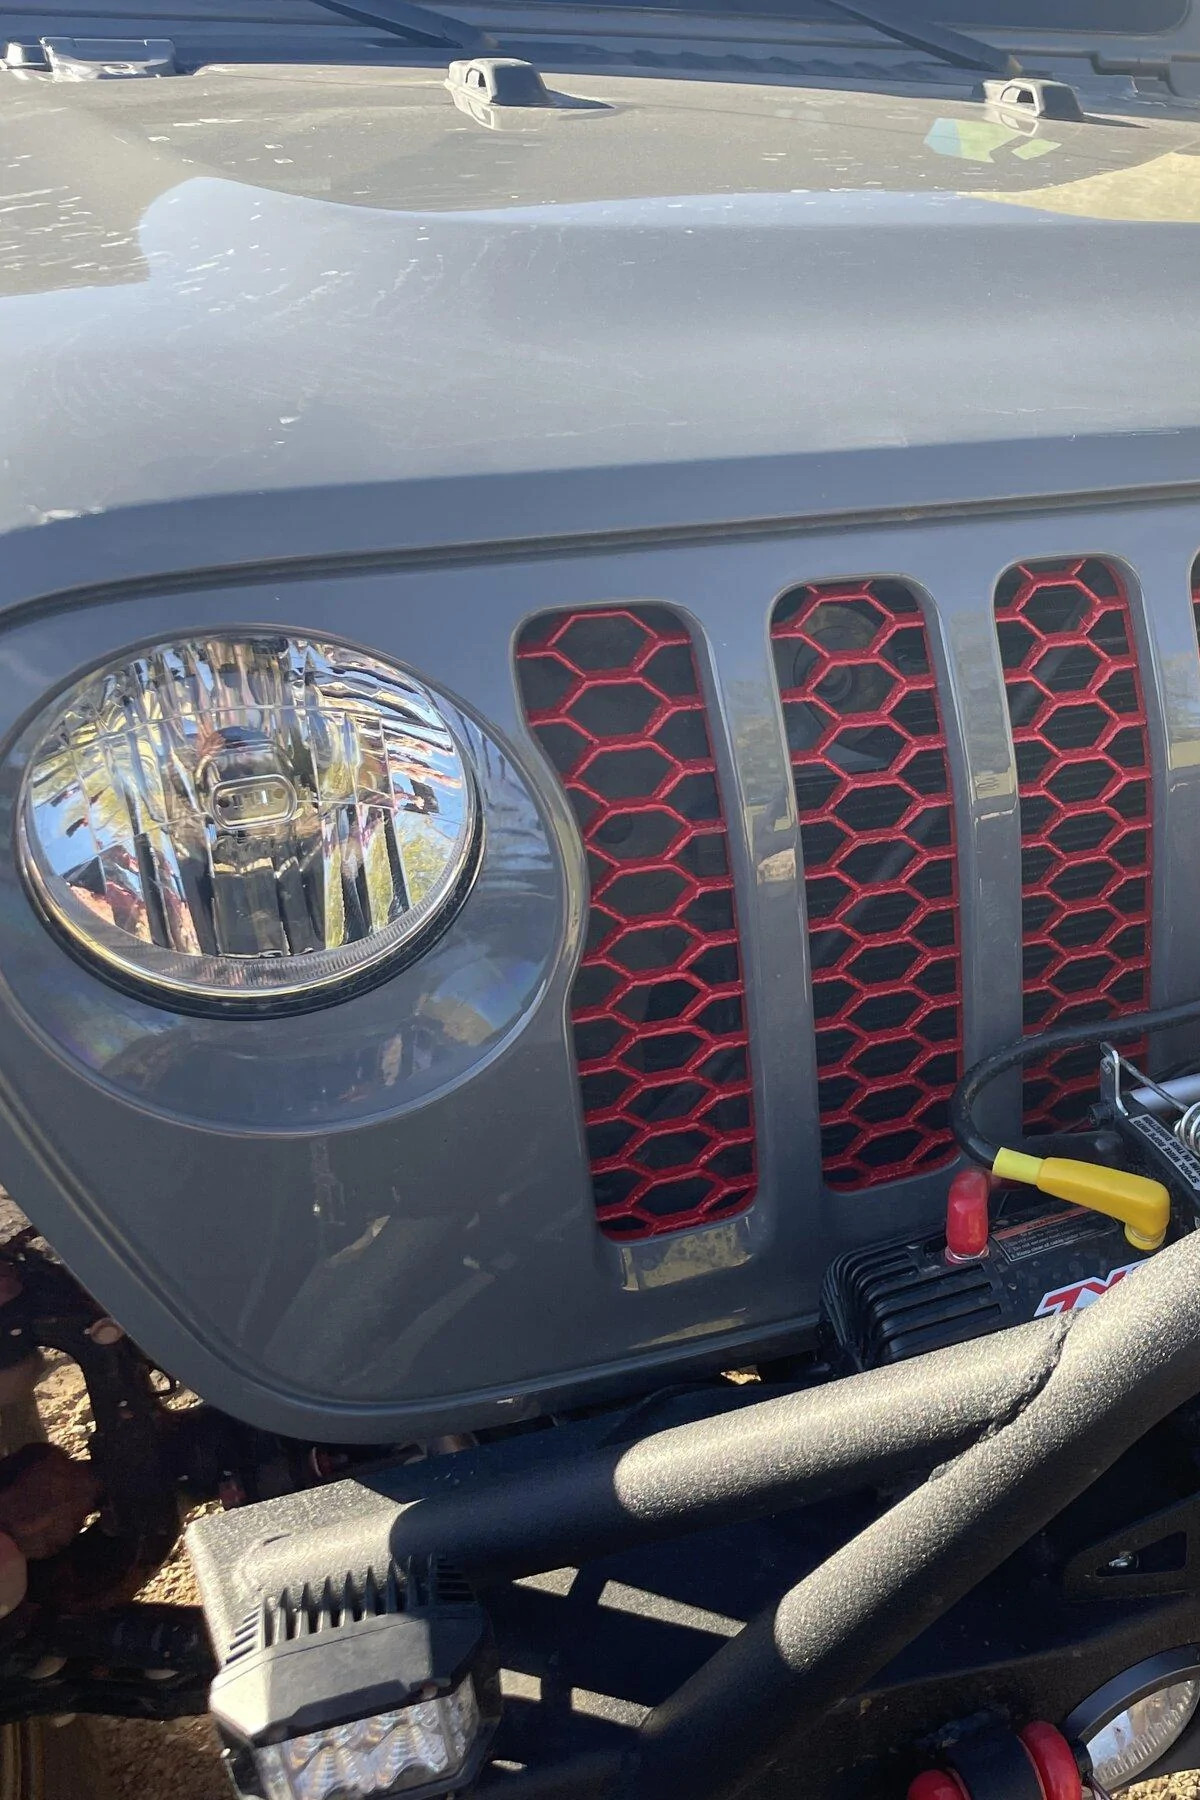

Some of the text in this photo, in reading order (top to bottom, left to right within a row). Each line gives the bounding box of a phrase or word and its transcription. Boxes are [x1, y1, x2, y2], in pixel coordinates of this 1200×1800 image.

[1142, 1116, 1172, 1141] DIRECTION
[1147, 1132, 1166, 1147] ROPE
[1162, 1146, 1181, 1163] WIRE
[1169, 1142, 1187, 1156] THIS
[1182, 1154, 1193, 1162] IN
[1178, 1163, 1200, 1184] SPOOL
